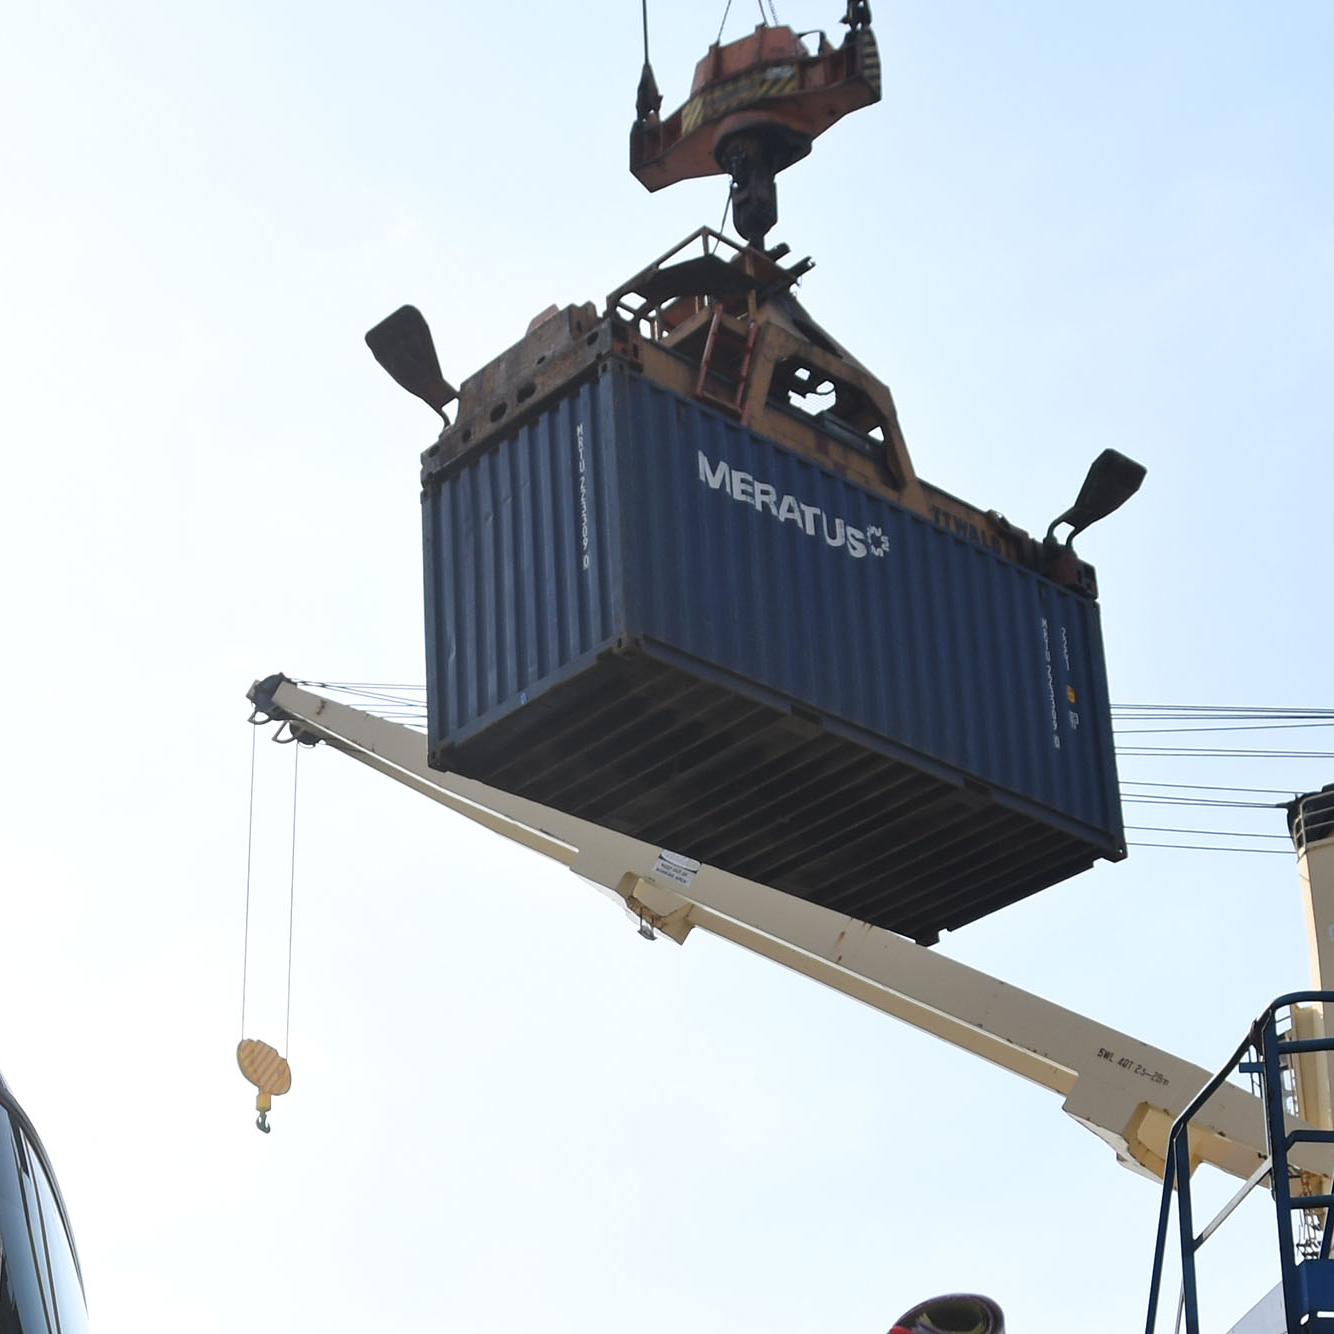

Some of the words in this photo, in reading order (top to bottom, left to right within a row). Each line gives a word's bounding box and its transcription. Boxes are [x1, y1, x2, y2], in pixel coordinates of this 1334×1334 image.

[576, 423, 586, 473] MRTU
[579, 476, 589, 551] 223309
[698, 449, 868, 559] MERATUS
[1097, 1047, 1116, 1063] SWL
